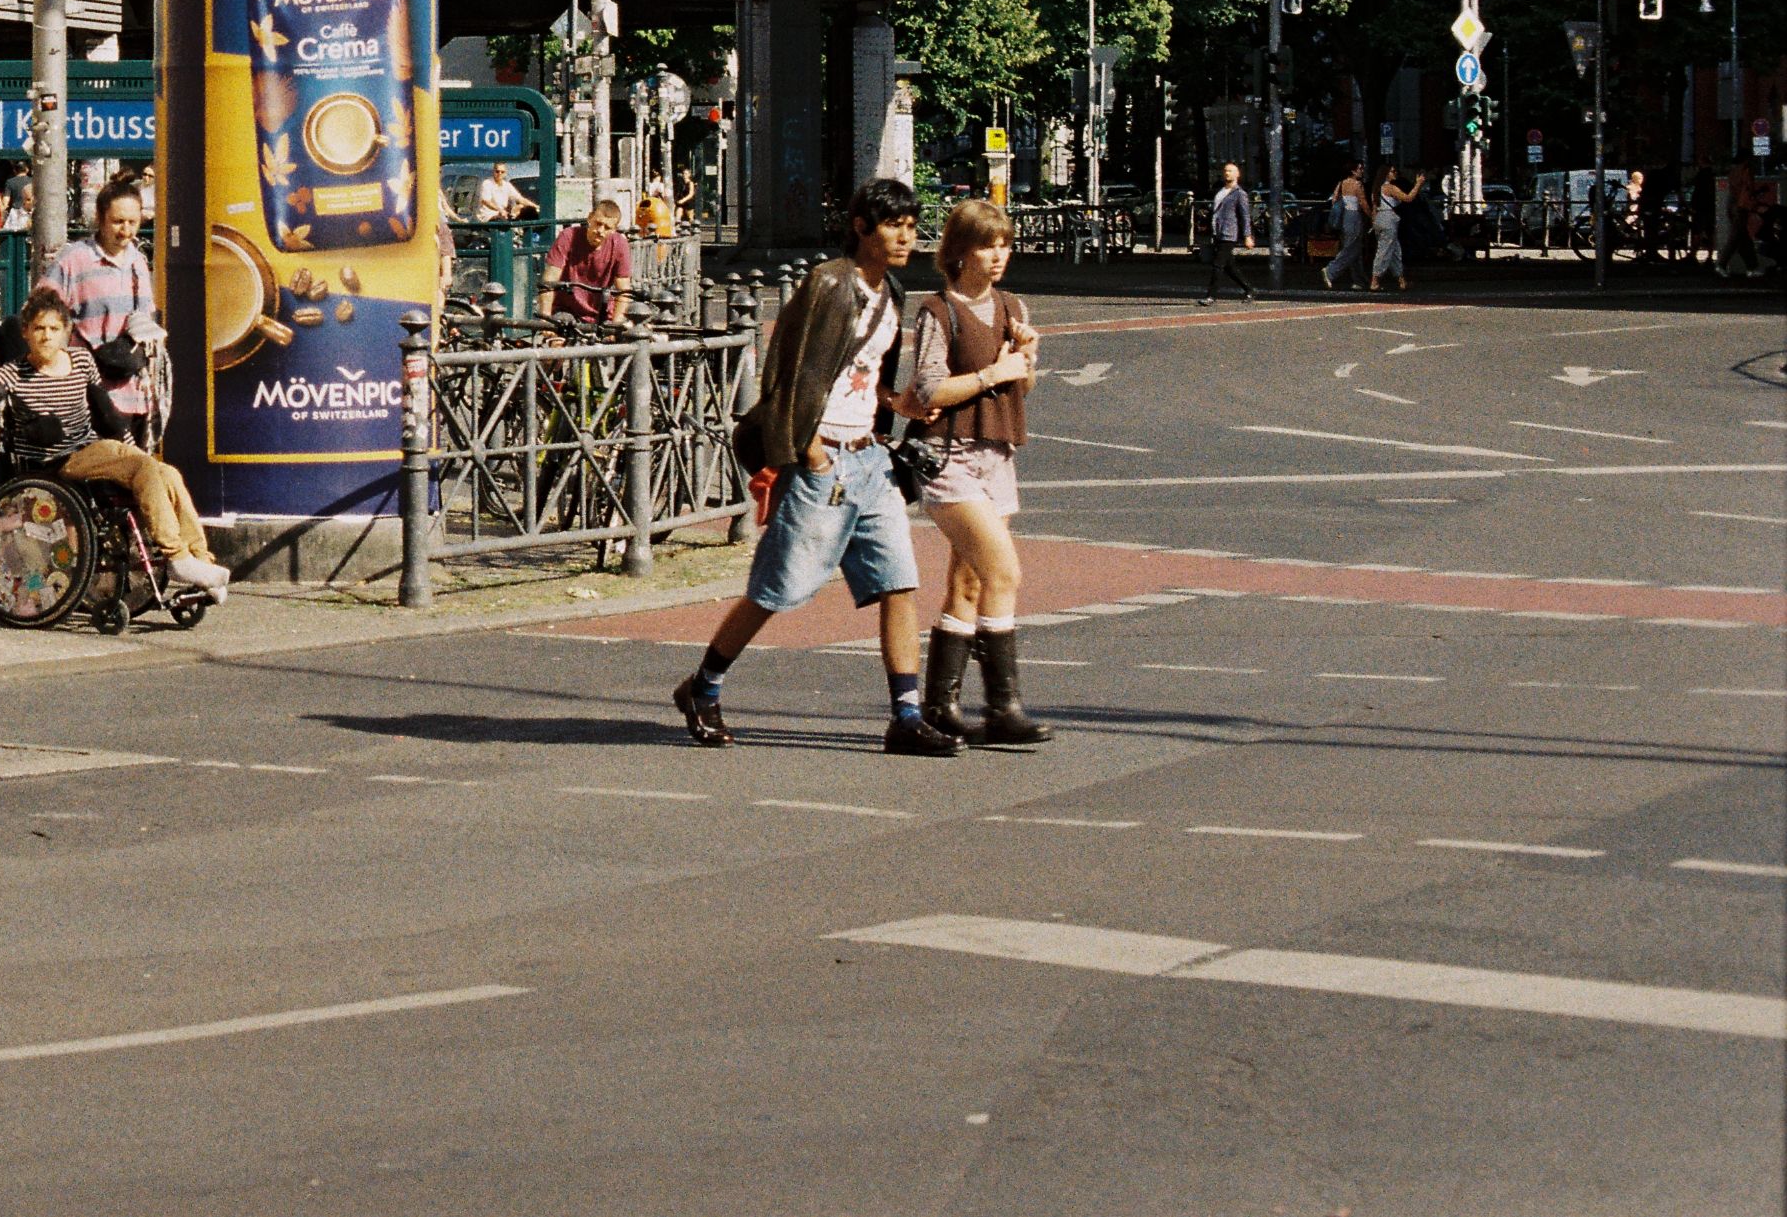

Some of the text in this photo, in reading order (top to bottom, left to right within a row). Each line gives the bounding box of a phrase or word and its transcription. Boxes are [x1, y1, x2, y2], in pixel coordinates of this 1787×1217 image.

[297, 37, 379, 62] Crema
[16, 107, 155, 140] Ktbuss
[468, 123, 511, 148] Tor
[252, 377, 402, 409] MÖVENPIC
[291, 409, 389, 421] OF SWITZERLAND
